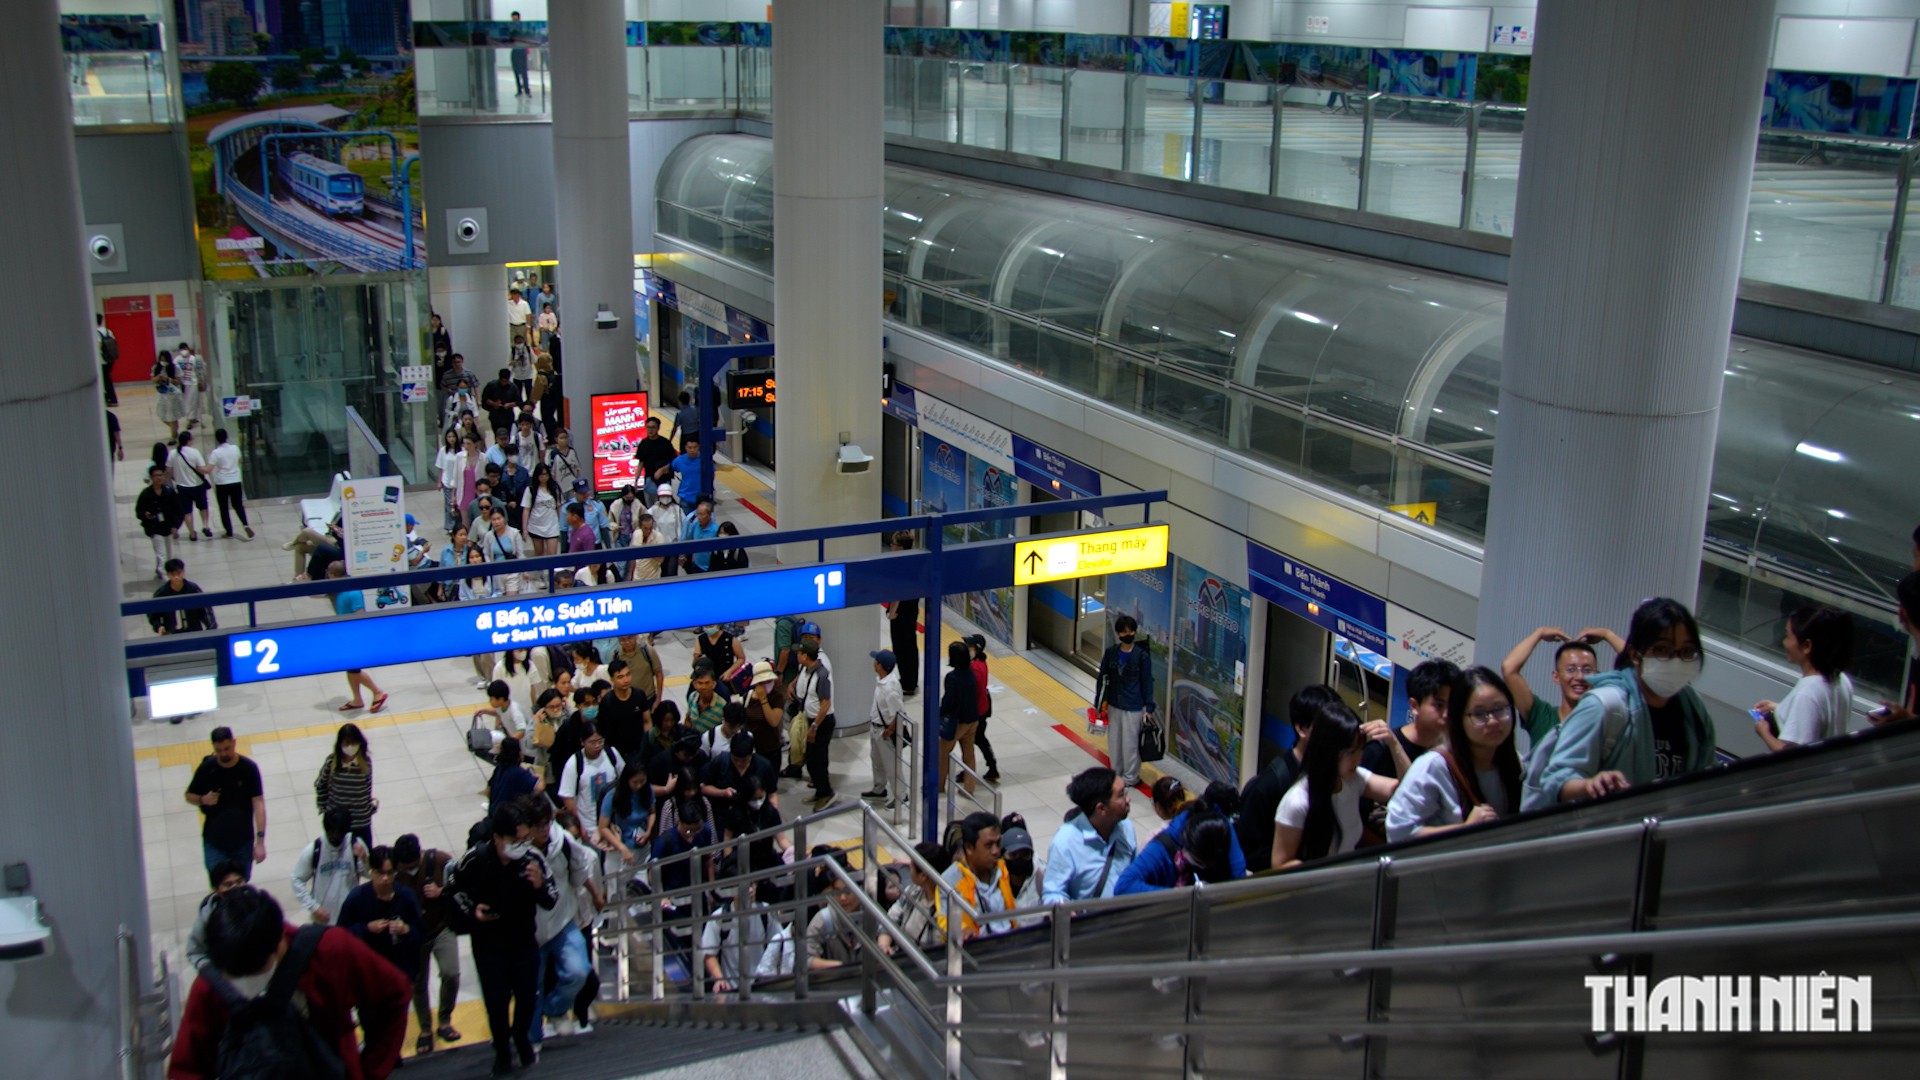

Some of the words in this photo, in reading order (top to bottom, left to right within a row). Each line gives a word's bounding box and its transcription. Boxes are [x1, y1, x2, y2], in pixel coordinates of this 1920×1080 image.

[883, 374, 889, 389] 1
[738, 387, 763, 397] 17:15
[604, 412, 635, 427] MẠNH
[1079, 541, 1117, 555] Thang
[1077, 558, 1113, 570] Elevator
[813, 573, 825, 605] 1
[1294, 567, 1309, 582] Bến
[1309, 573, 1331, 592] Thành
[476, 611, 493, 630] đi
[496, 607, 529, 628] Bến
[532, 605, 555, 623] Xe
[558, 598, 595, 620] Suối
[597, 597, 633, 615] Tiên
[491, 630, 510, 644] for
[511, 628, 538, 643] Suoi
[539, 625, 566, 639] Tien
[566, 617, 619, 636] Terminal
[255, 638, 280, 674] 2
